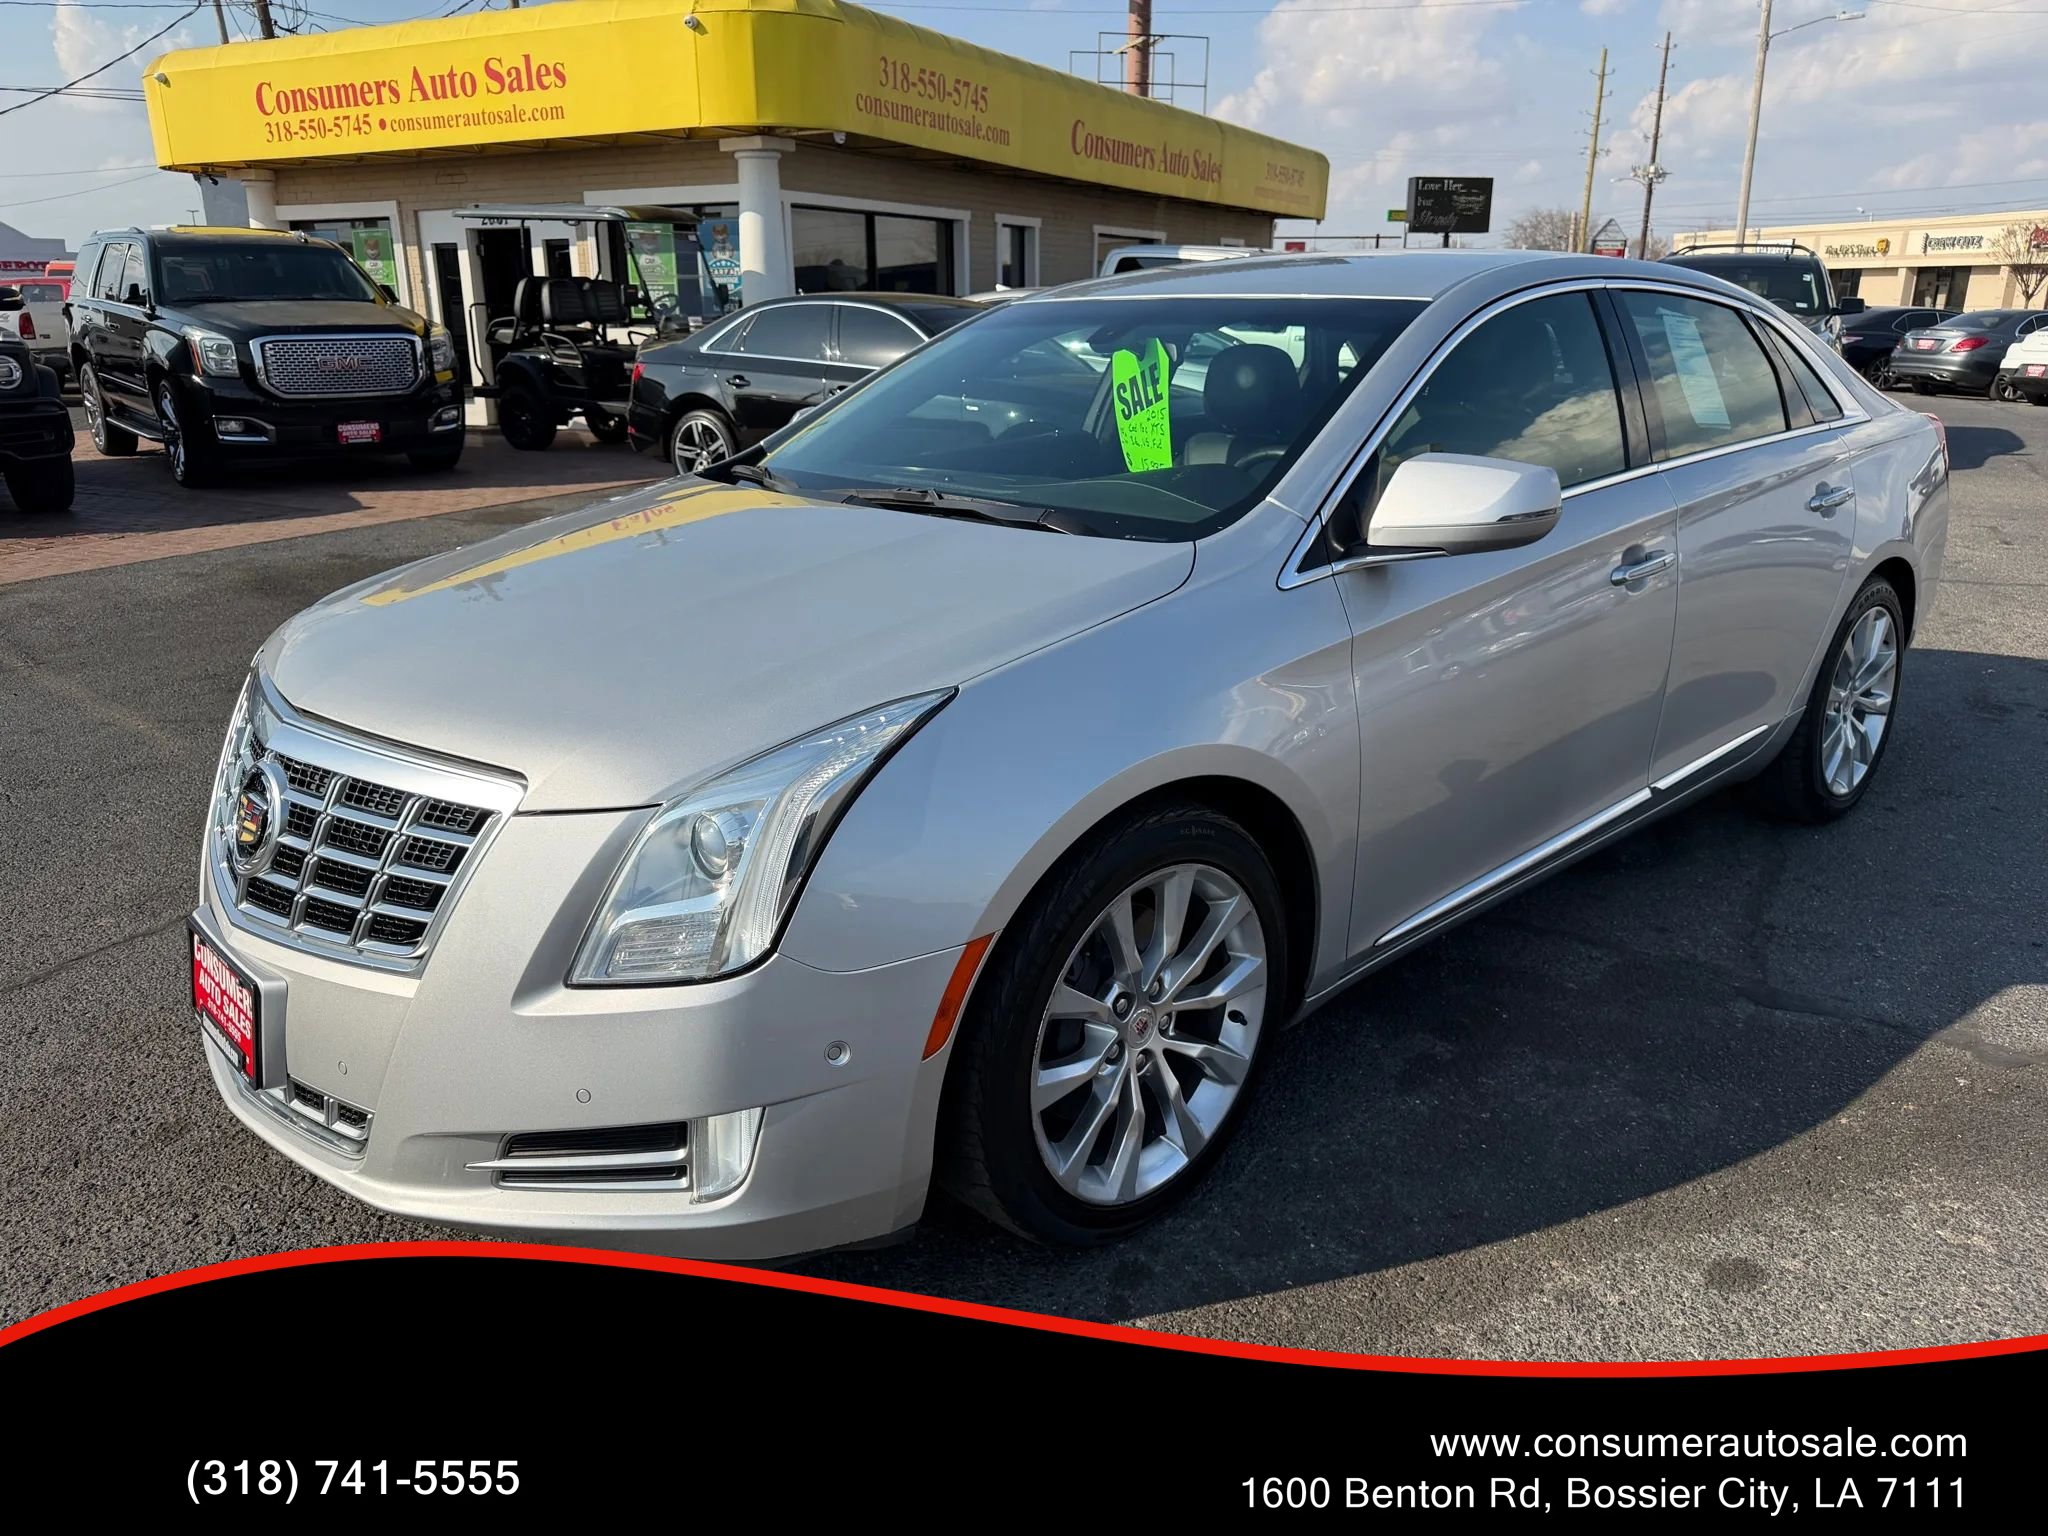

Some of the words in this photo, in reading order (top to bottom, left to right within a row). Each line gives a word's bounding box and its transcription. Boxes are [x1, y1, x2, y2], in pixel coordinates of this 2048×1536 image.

[256, 79, 400, 116] Consumers
[408, 64, 477, 103] Auto
[484, 53, 567, 96] Sales
[879, 56, 988, 113] 318-550-5745
[264, 113, 372, 143] 318-550-5745
[390, 103, 565, 133] consumerautosale.com
[856, 92, 1010, 146] consumerautosale.com
[1071, 119, 1155, 171] Consumers
[1157, 142, 1190, 178] Auto
[1191, 149, 1223, 184] Sales
[1418, 180, 1442, 191] Love
[317, 356, 373, 369] GMC
[1116, 362, 1164, 420] SALE
[1147, 407, 1167, 422] 2015
[199, 967, 221, 1006] AUTO
[223, 994, 252, 1040] SALES
